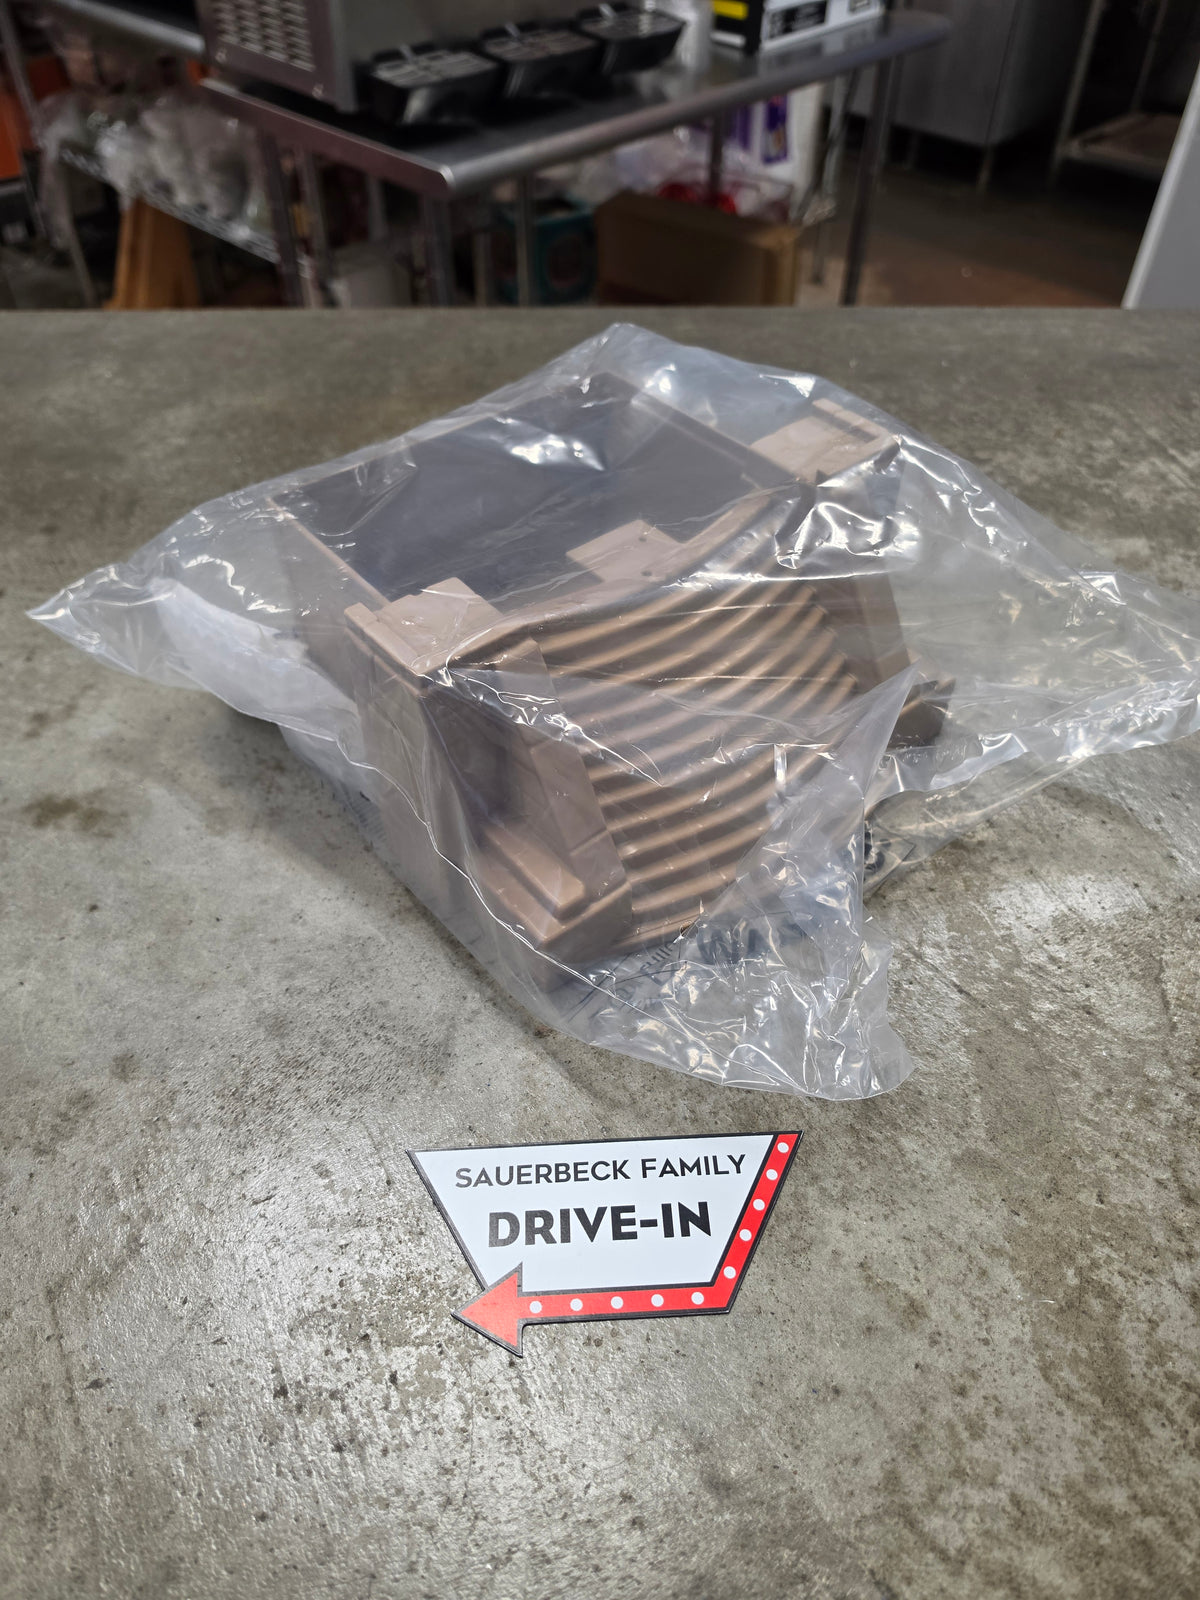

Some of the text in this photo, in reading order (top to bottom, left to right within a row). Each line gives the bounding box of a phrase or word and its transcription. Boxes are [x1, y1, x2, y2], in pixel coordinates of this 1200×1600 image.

[455, 1154, 746, 1188] SAUERBECK FAMILY
[488, 1201, 712, 1248] DRIVE-IN
